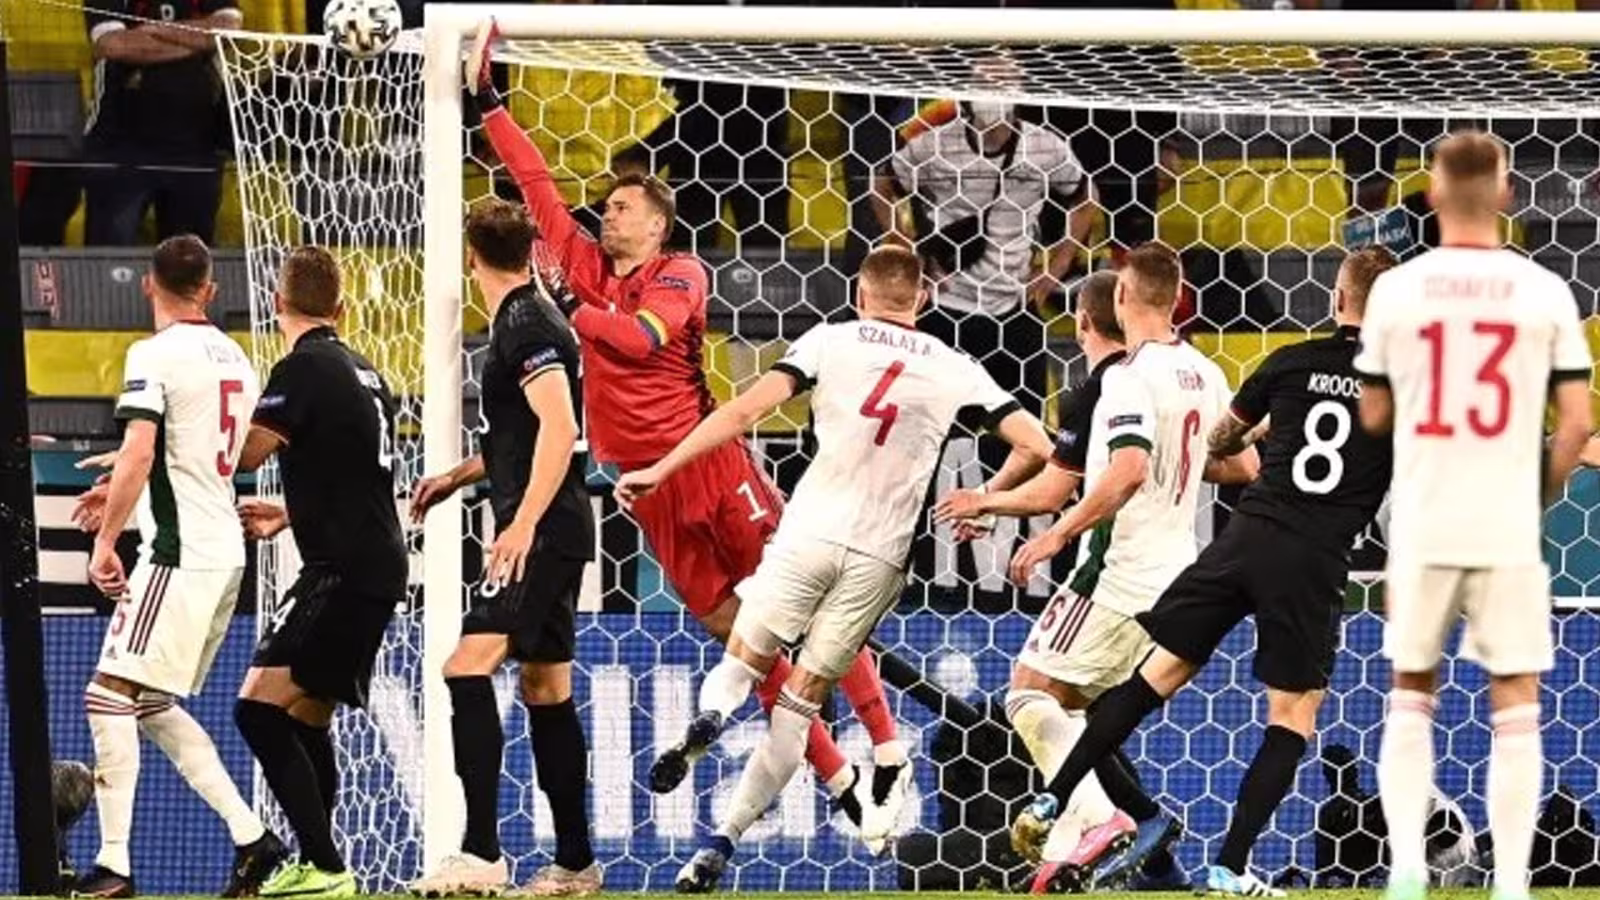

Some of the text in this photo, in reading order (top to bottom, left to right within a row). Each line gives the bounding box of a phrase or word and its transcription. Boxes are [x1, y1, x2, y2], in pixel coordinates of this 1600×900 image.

[861, 359, 905, 447] 4
[1307, 372, 1364, 399] KROOS
[1413, 319, 1520, 441] 13
[216, 379, 244, 477] 5
[1292, 400, 1352, 494] 8
[736, 481, 769, 522] 1
[271, 596, 297, 634] 4
[1040, 594, 1066, 632] 6
